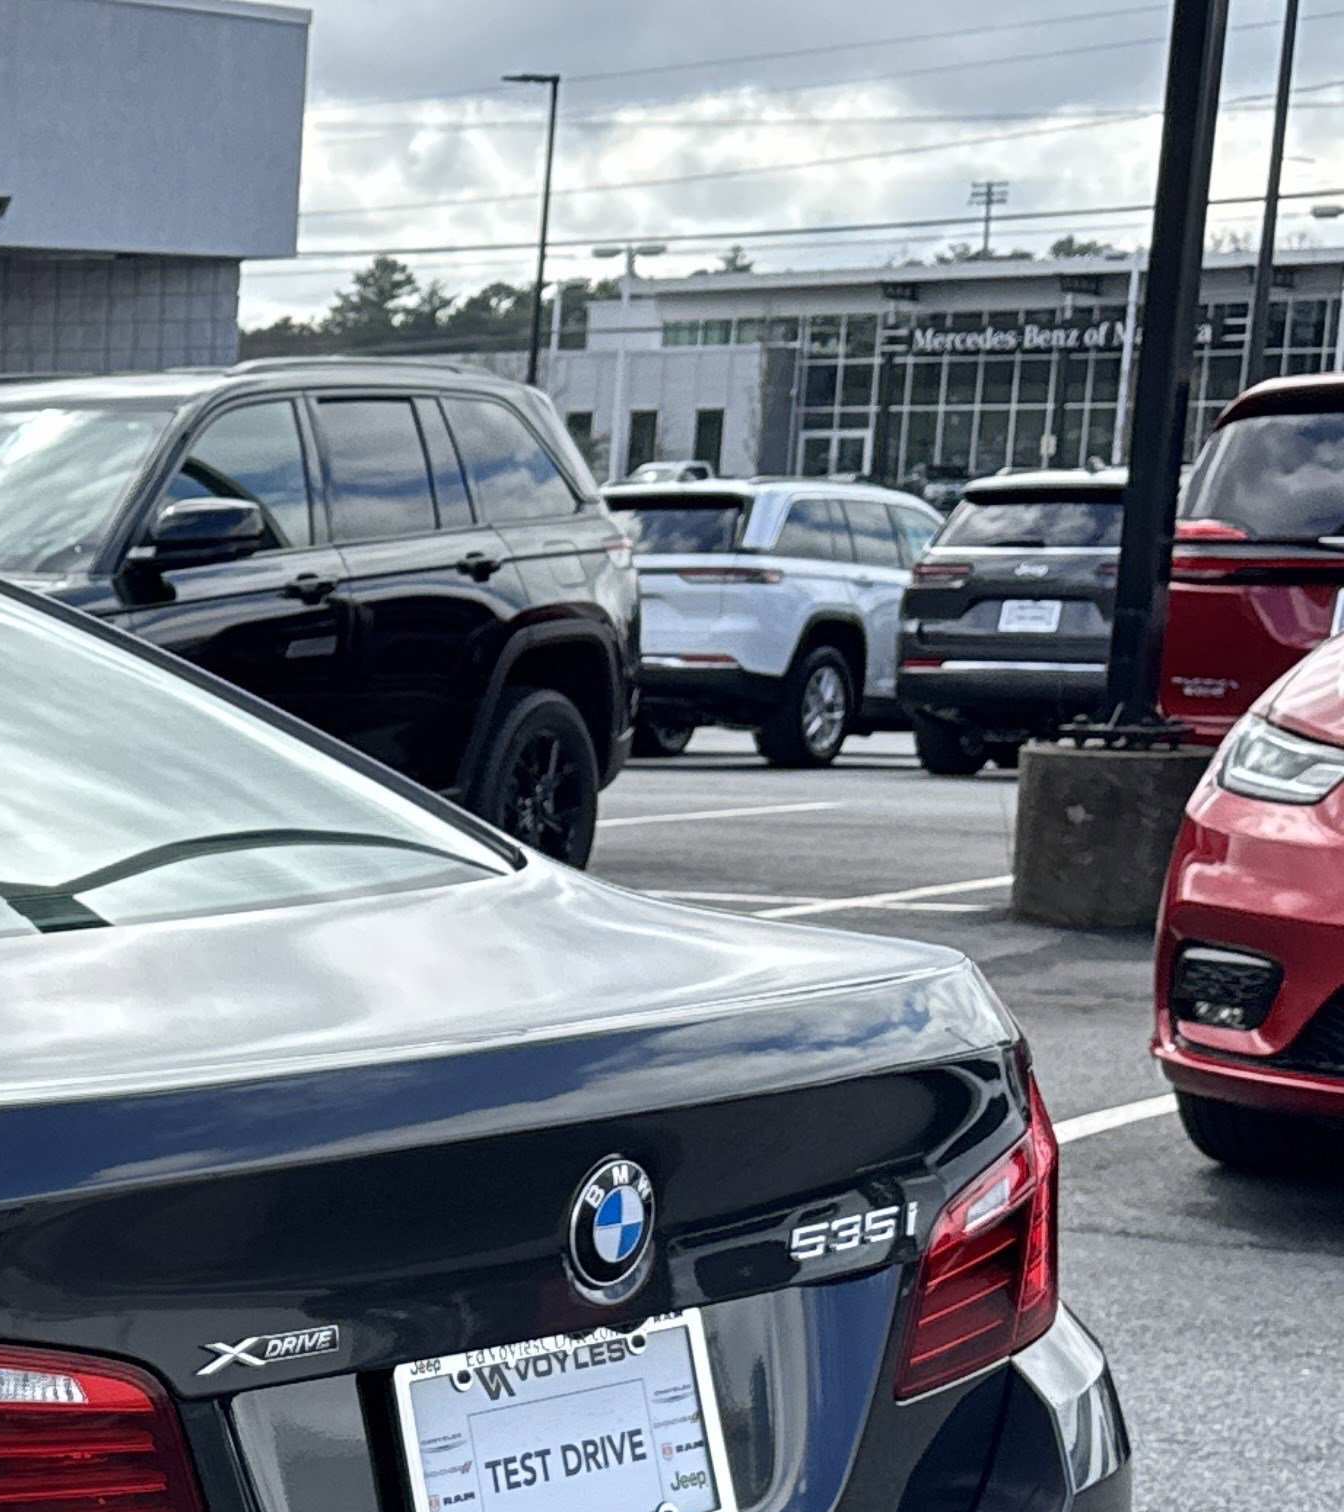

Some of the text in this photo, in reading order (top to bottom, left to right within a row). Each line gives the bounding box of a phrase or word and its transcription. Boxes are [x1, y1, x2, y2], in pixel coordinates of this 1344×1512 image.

[913, 323, 1080, 350] Mercedes-Benz
[1084, 321, 1110, 348] of
[584, 1164, 652, 1209] BMW
[790, 1200, 918, 1260] 535i
[513, 1339, 626, 1382] VOYLES
[484, 1428, 648, 1494] TEST DRIVE
[670, 1470, 707, 1491] Jeep
[443, 1492, 475, 1506] RAM
